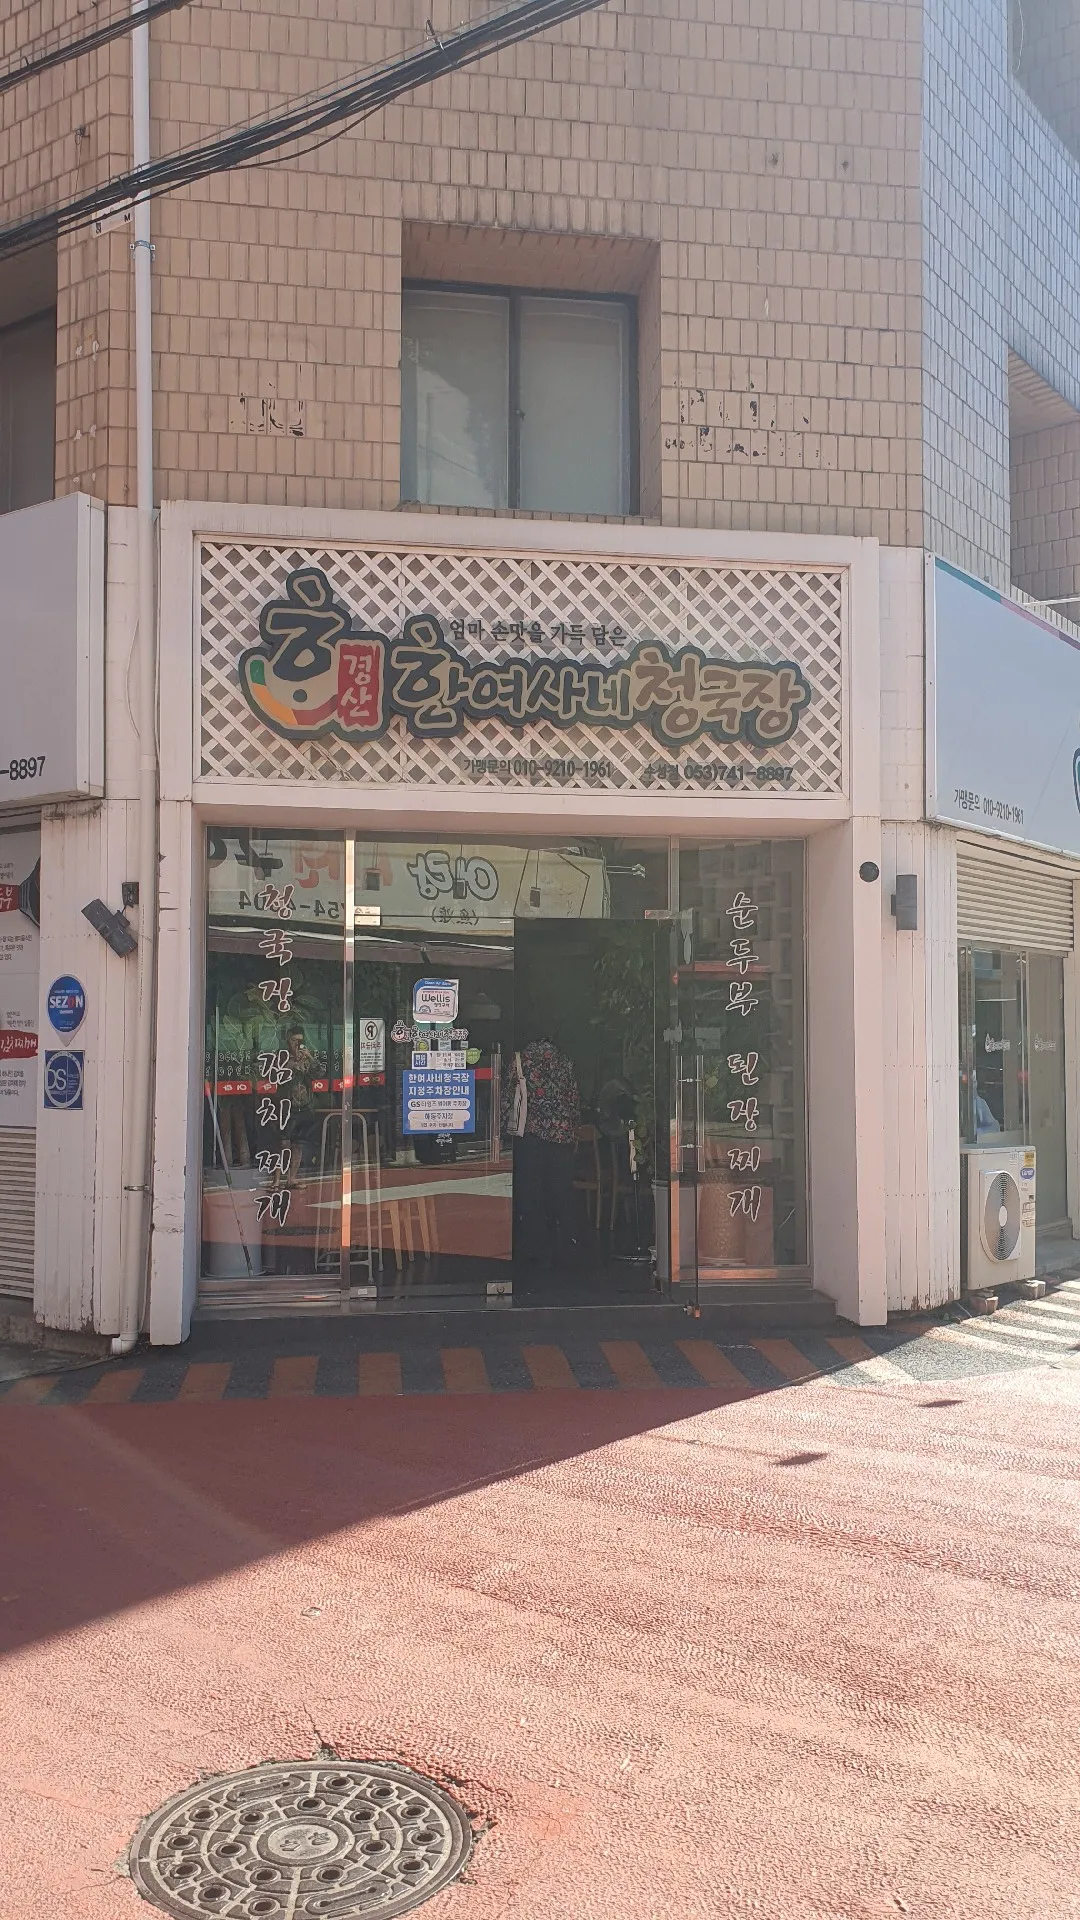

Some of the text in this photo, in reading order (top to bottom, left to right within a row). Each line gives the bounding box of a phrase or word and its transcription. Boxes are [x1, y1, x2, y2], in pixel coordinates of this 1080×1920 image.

[450, 618, 628, 647] 엄마 손맛을 가득 담은
[340, 650, 377, 722] 경산
[390, 616, 808, 738] 한여사네 청국장
[463, 758, 613, 778] 가맹문의 010-9210-1961
[683, 763, 794, 782] 053)741-8897
[954, 788, 1024, 825] 가맹문의 010-9210-1961
[258, 884, 294, 1012] 청국장
[726, 892, 759, 1016] 순두부
[421, 994, 451, 1003] Wellis
[408, 1073, 470, 1083] 한여사네청국장
[254, 1049, 294, 1227] 김치찌개
[726, 1052, 762, 1223] 된장찌개
